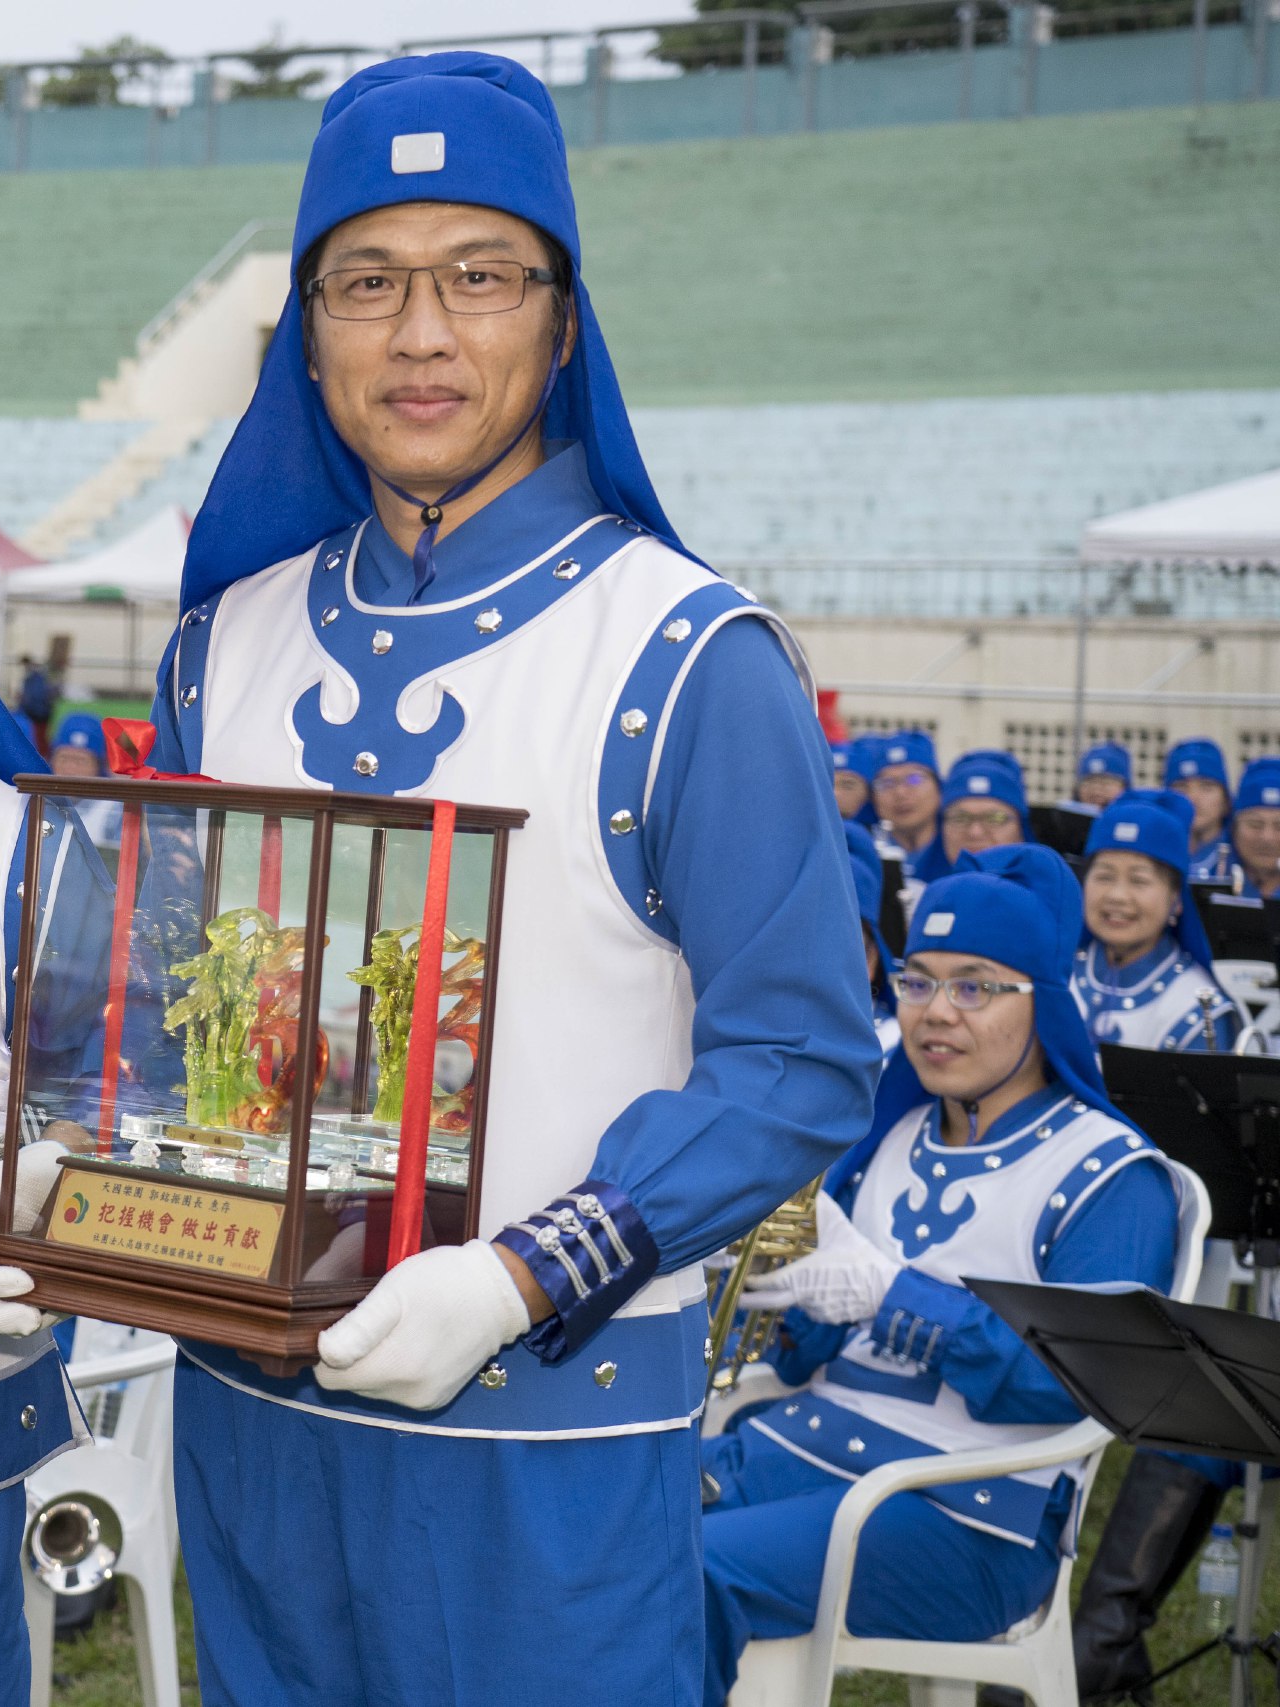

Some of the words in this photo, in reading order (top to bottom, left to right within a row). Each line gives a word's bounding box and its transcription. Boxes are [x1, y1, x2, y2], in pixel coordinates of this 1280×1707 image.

[102, 1182, 144, 1199] 天國樂團
[98, 1202, 175, 1235] 把握機會
[181, 1217, 261, 1250] 做出貢獻
